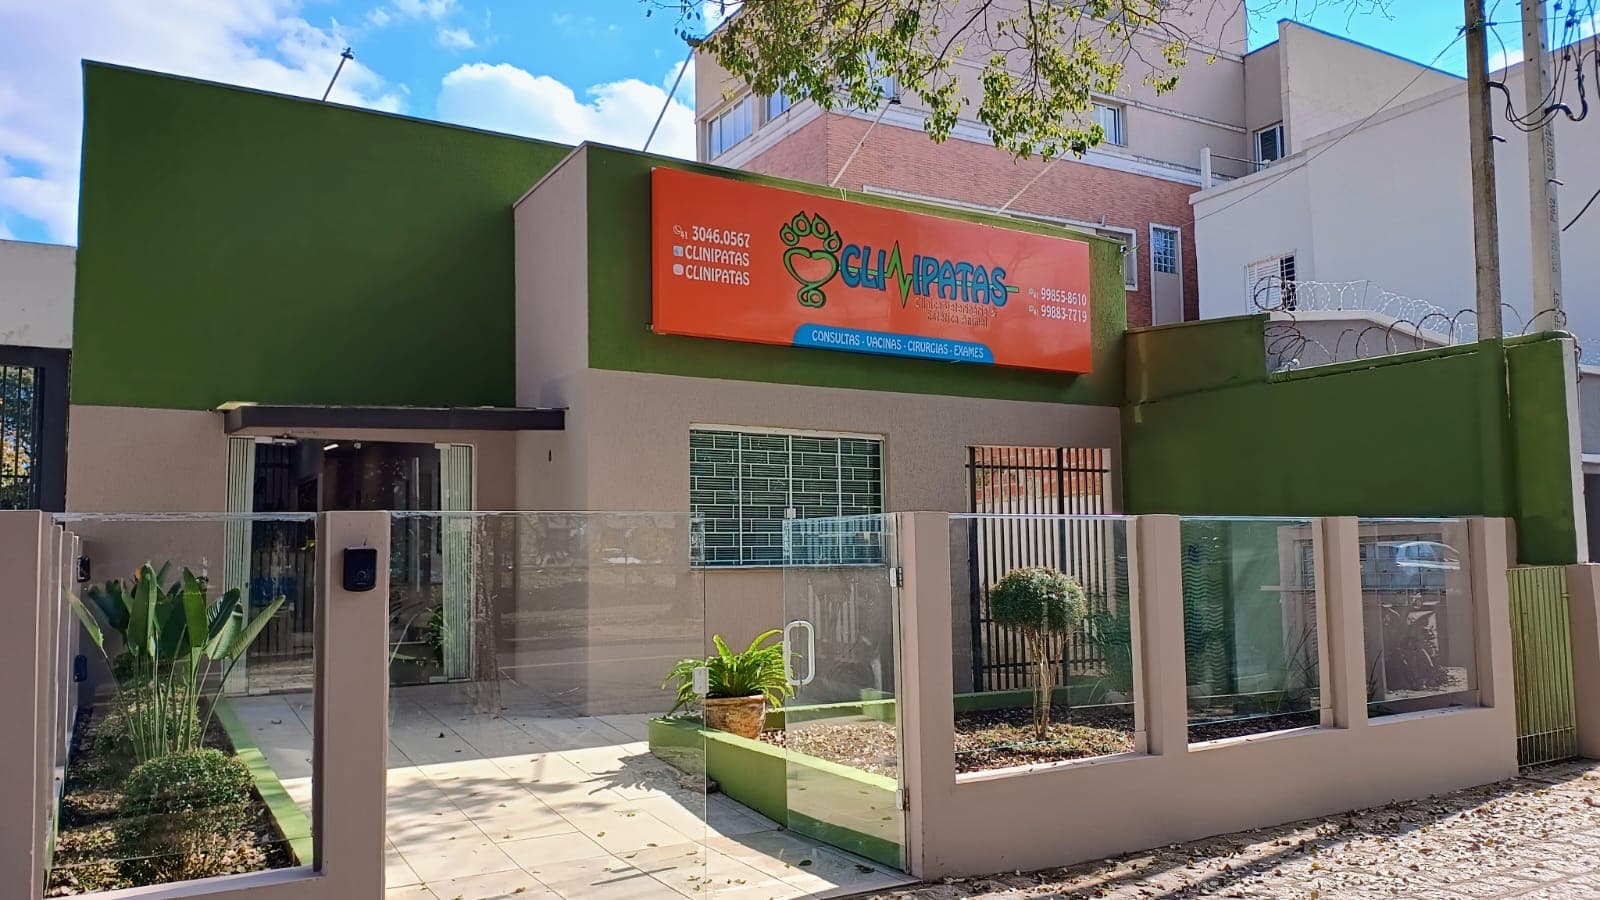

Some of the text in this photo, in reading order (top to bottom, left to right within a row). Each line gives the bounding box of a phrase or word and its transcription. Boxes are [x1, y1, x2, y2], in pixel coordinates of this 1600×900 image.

[691, 225, 750, 248] 3046.0567
[685, 245, 750, 267] CLINIPATAS
[685, 264, 750, 286] CLINIPATAS
[840, 240, 1008, 308] CLINIPATAS
[1041, 287, 1087, 306] 99855-8610
[1041, 304, 1087, 323] 99883-7719
[812, 330, 860, 347] CONSULTAS
[866, 336, 902, 351] VACINAS
[907, 340, 948, 356] CIRURGIAS
[954, 345, 984, 359] EXAMES
